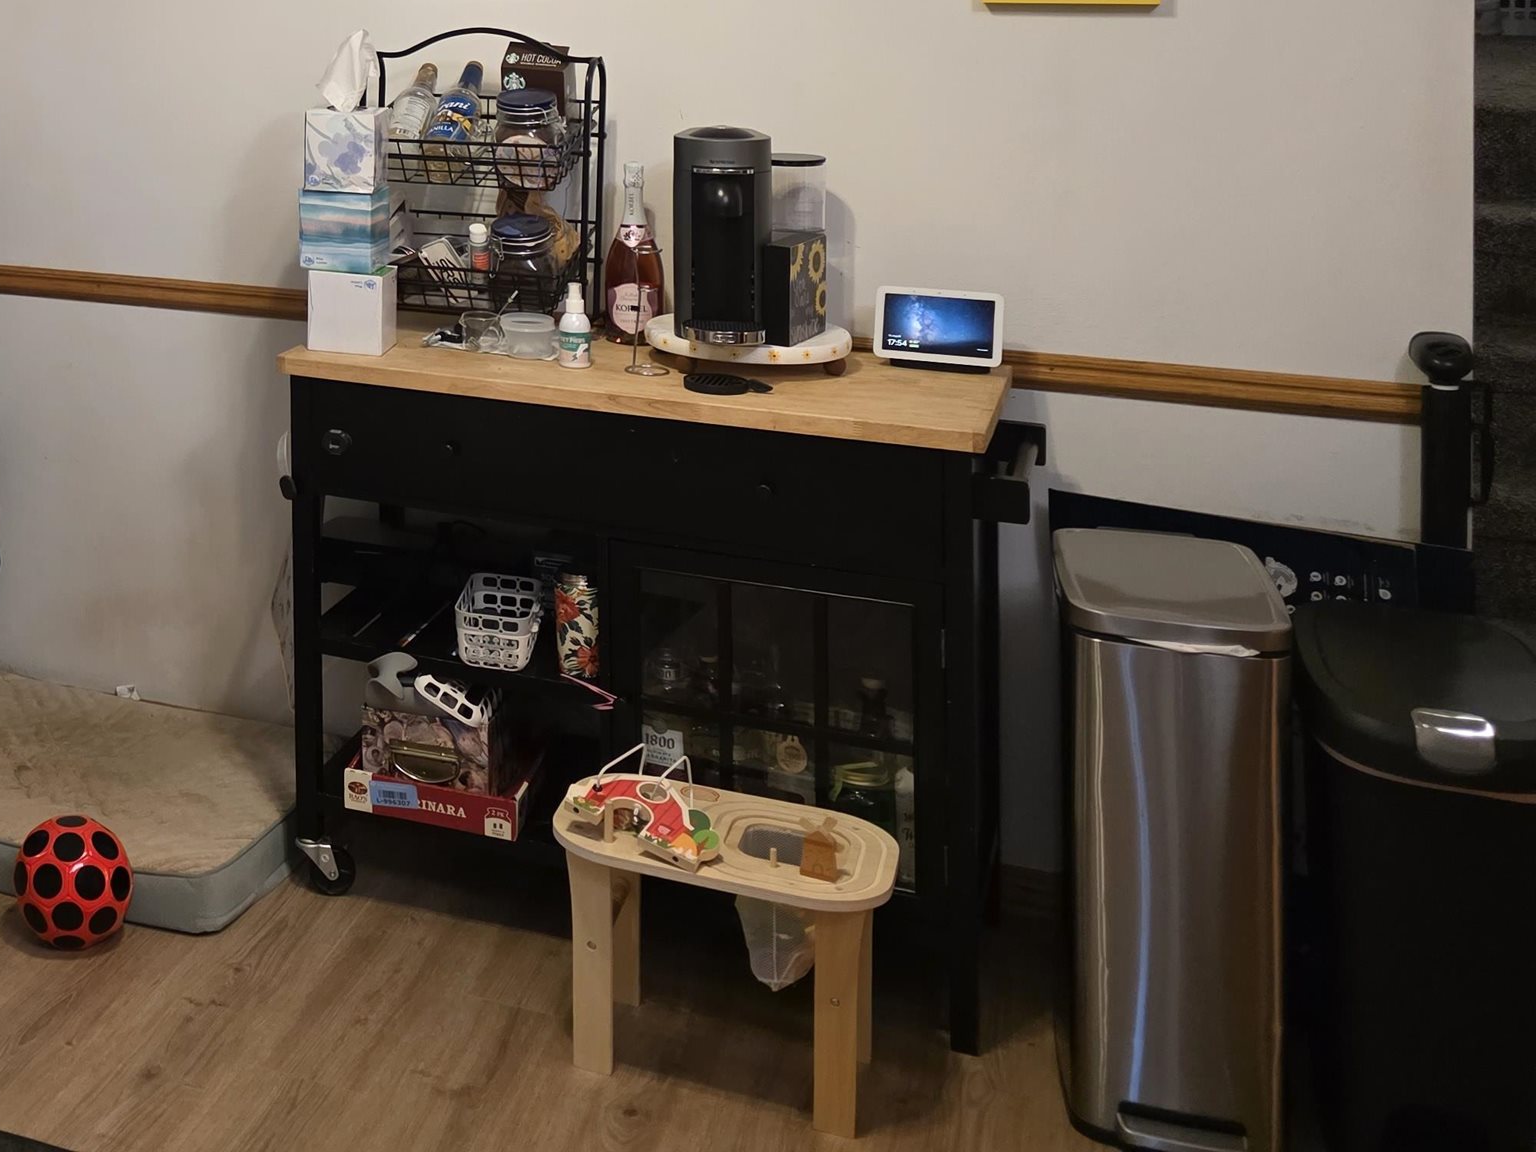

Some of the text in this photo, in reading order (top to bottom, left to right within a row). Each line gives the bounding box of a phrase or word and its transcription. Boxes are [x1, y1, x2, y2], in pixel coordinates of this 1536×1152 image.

[521, 53, 537, 62] HOT
[887, 338, 907, 347] 17:54
[644, 733, 675, 749] 1800
